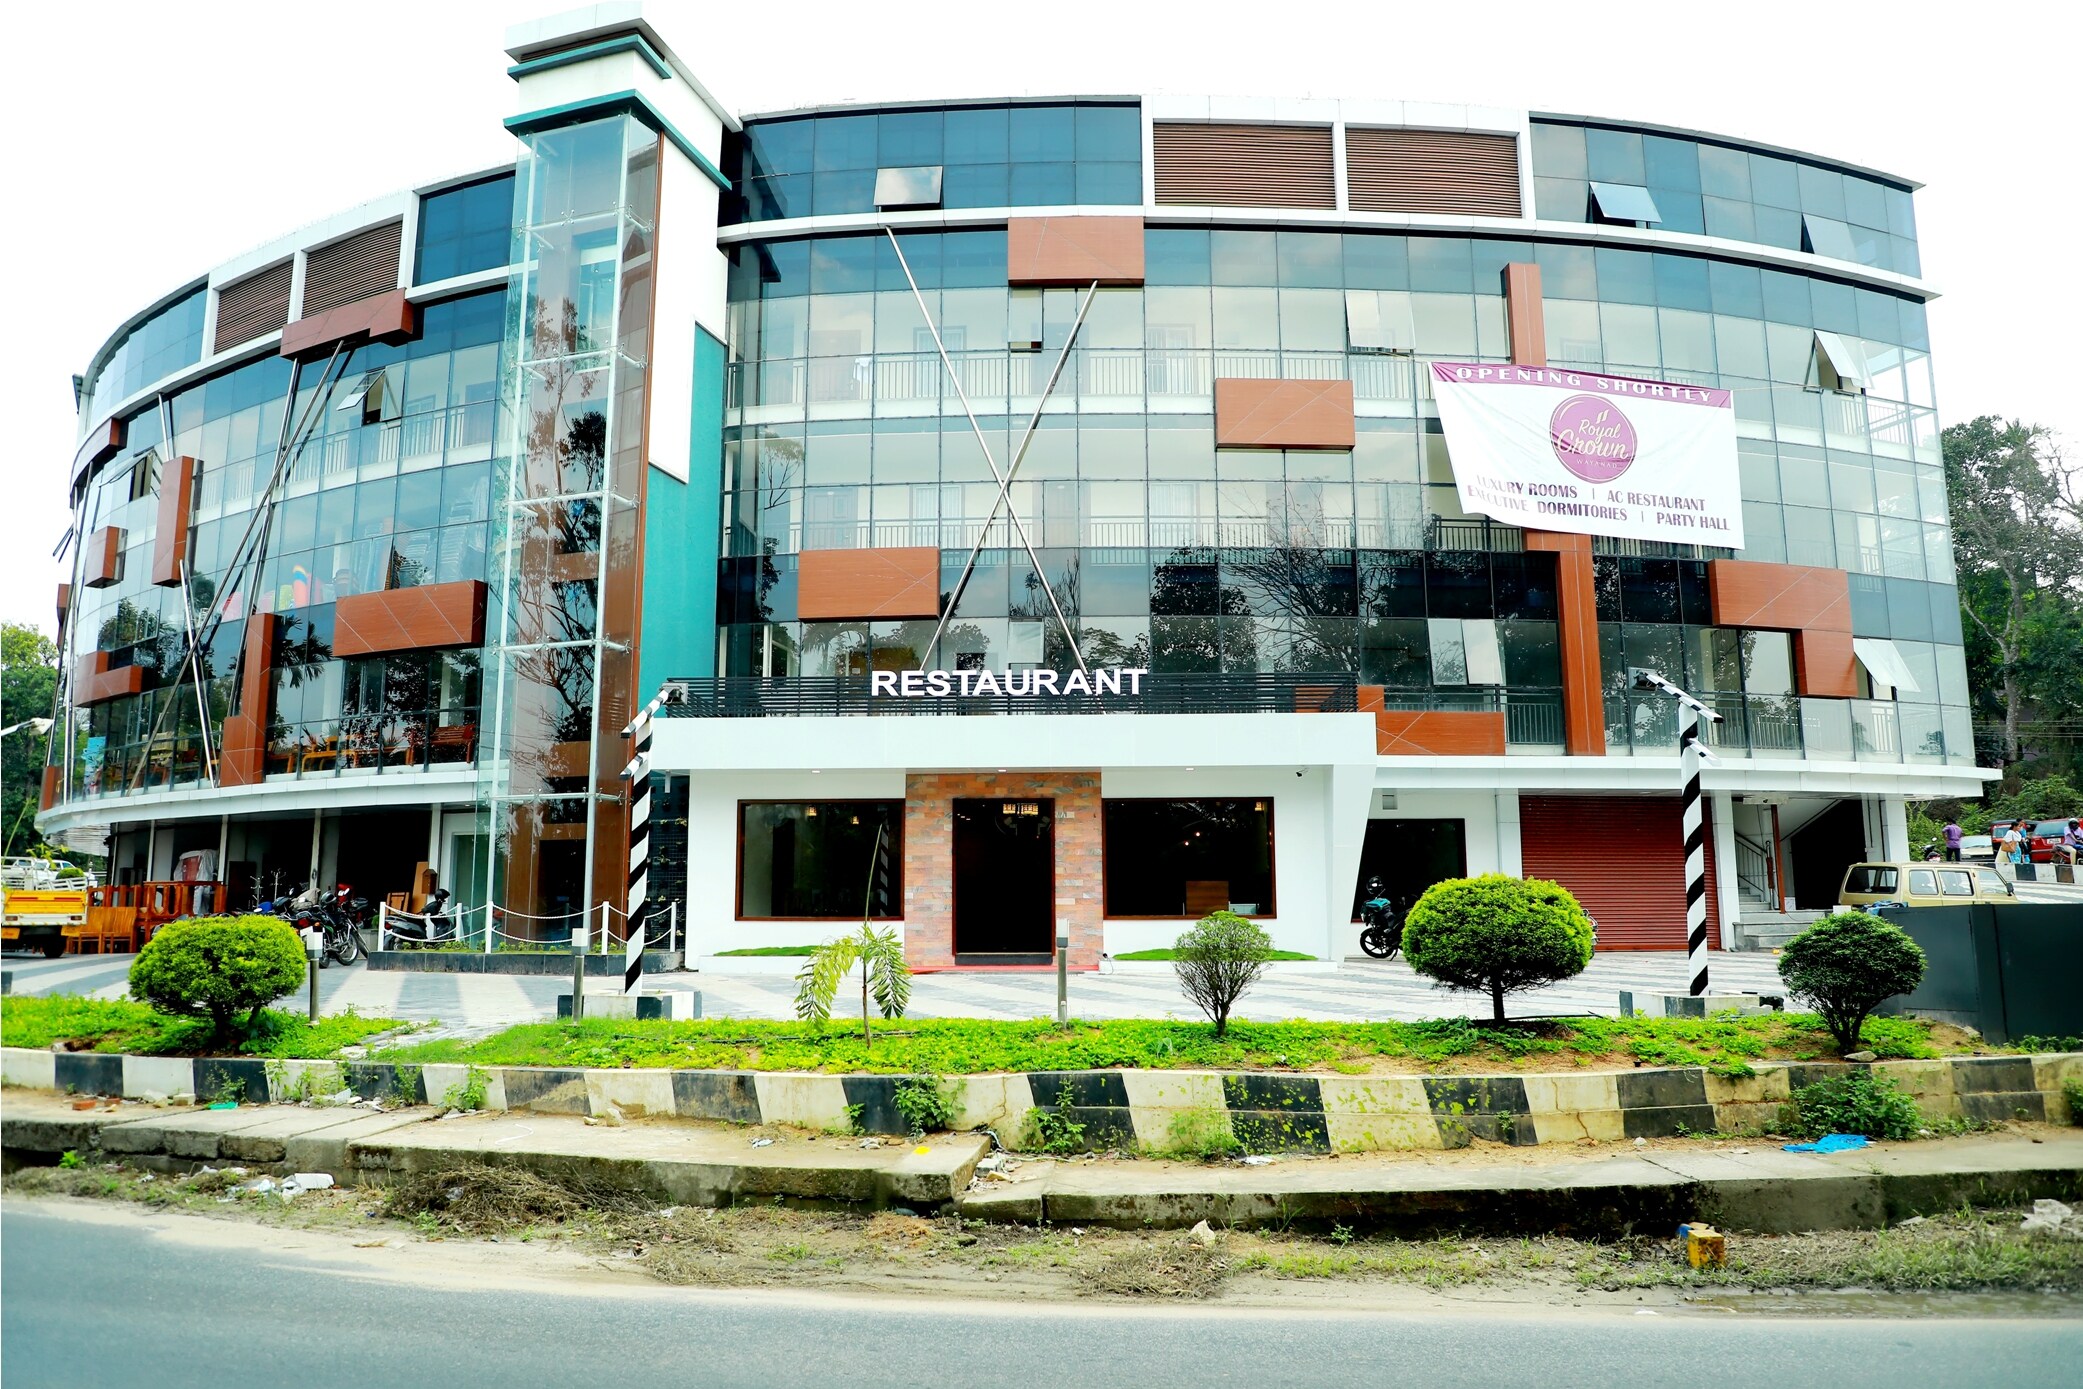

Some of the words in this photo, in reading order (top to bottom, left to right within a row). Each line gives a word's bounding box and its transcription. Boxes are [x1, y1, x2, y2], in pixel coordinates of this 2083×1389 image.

[1456, 366, 1582, 387] OPENING
[1596, 378, 1712, 403] SHORTLY
[1557, 429, 1629, 459] Crown
[1578, 418, 1621, 444] Royal
[1577, 459, 1618, 469] WAYANAD
[1476, 474, 1524, 496] LUXURY
[1528, 482, 1578, 499] ROOMS
[1467, 485, 1529, 511] EXECUTIVE
[1537, 500, 1628, 521] DORMITORIES
[1607, 489, 1623, 504] AC
[1627, 491, 1706, 512] RESTAURANT
[1656, 511, 1696, 528] PARTY
[1699, 516, 1731, 531] HALL
[870, 668, 1148, 697] RESTAURANT
